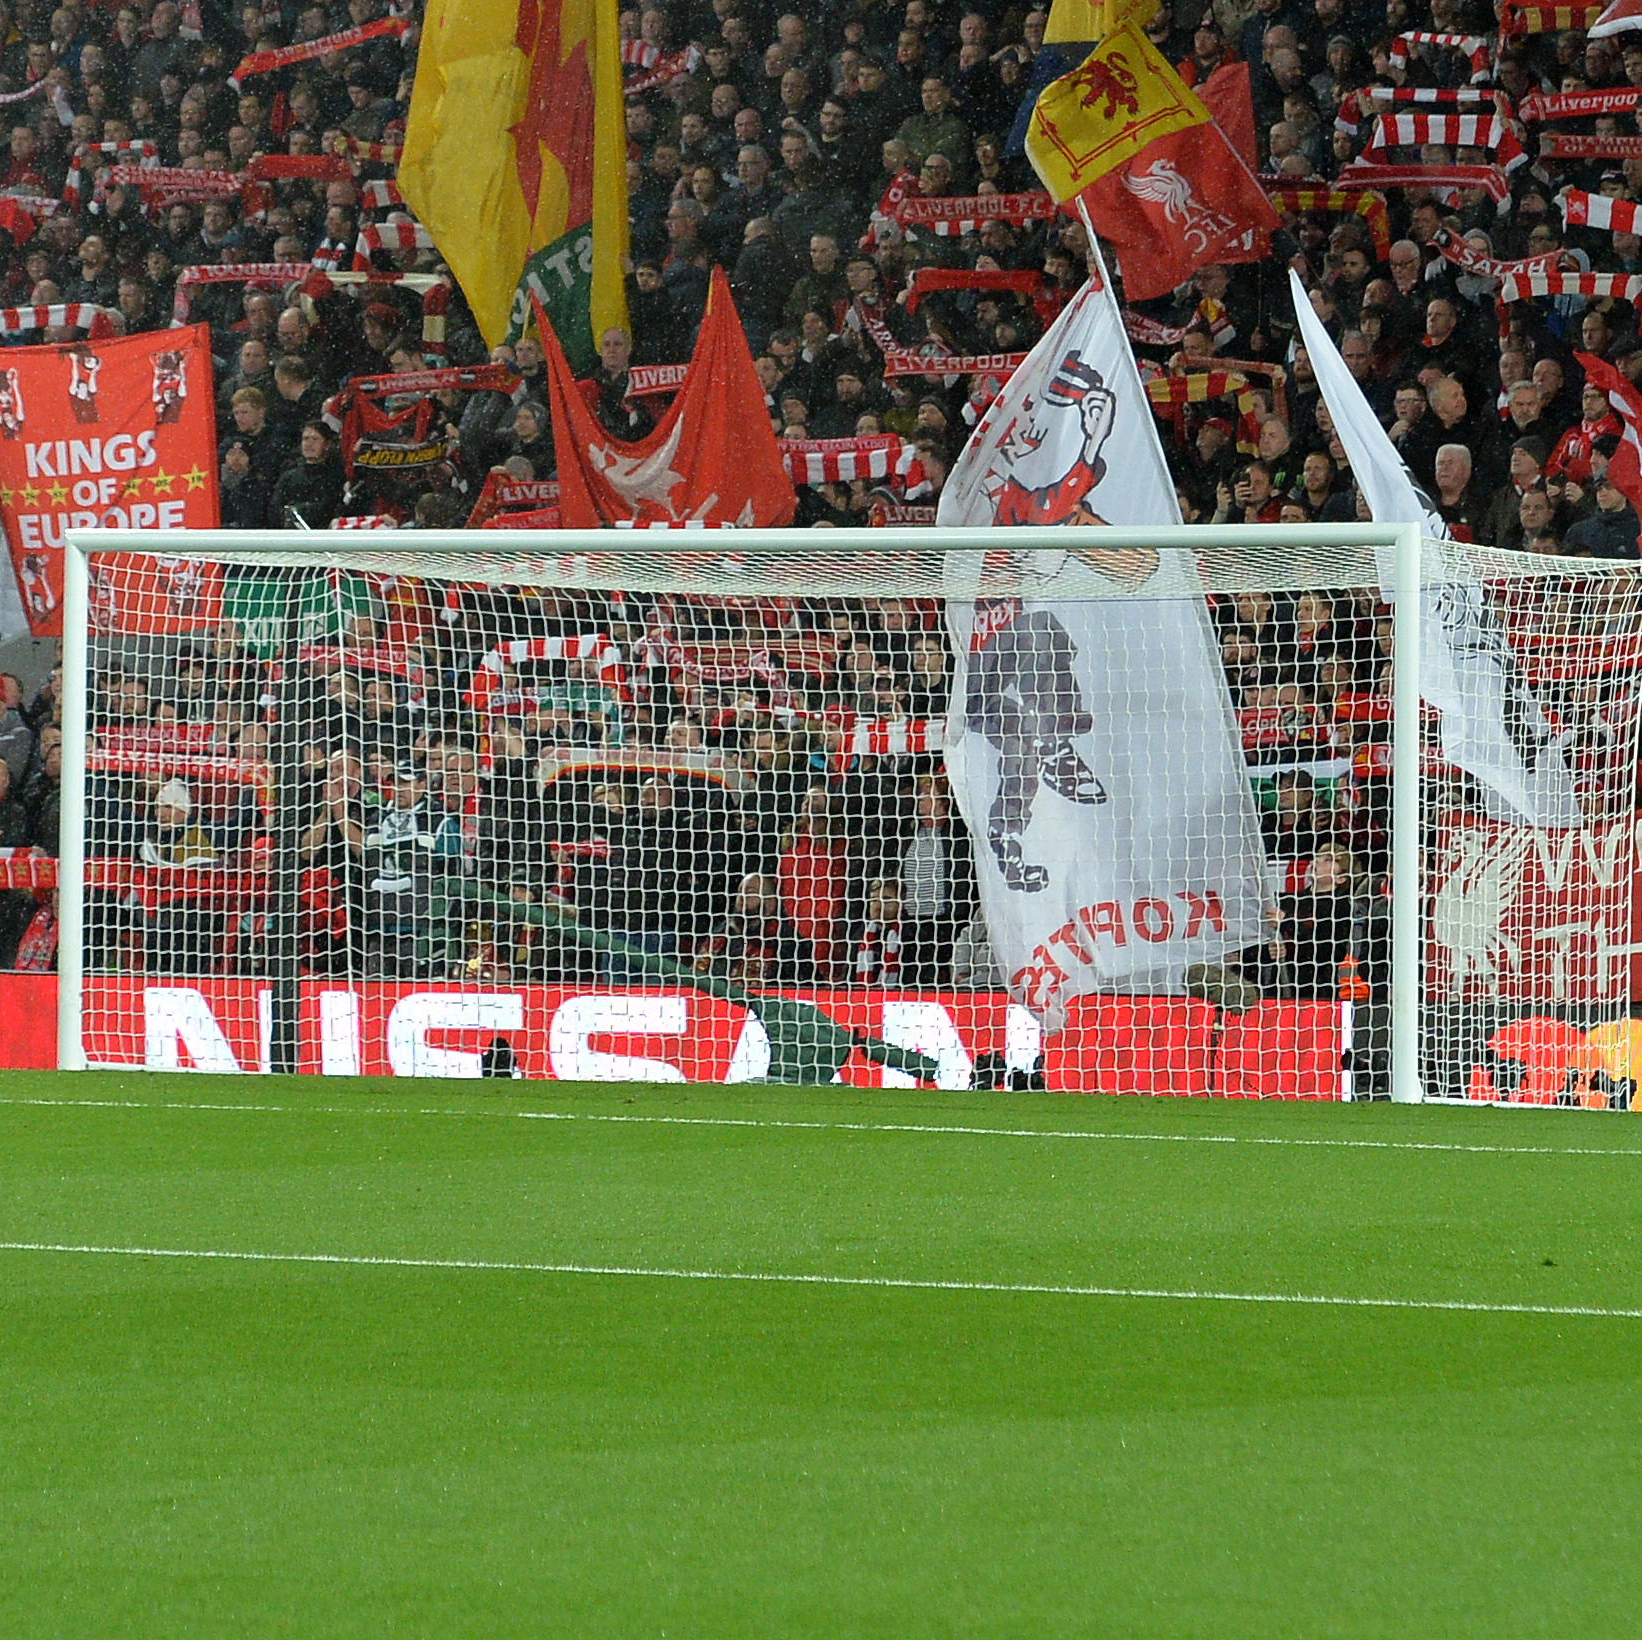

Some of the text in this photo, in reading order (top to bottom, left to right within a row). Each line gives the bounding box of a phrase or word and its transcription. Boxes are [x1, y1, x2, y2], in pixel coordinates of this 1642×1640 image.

[1542, 93, 1638, 112] Liverpoo
[915, 198, 1010, 218] LIVERPOOL
[893, 353, 1019, 372] LIVERPOOL
[24, 429, 158, 478] KINGS
[71, 477, 118, 507] OF
